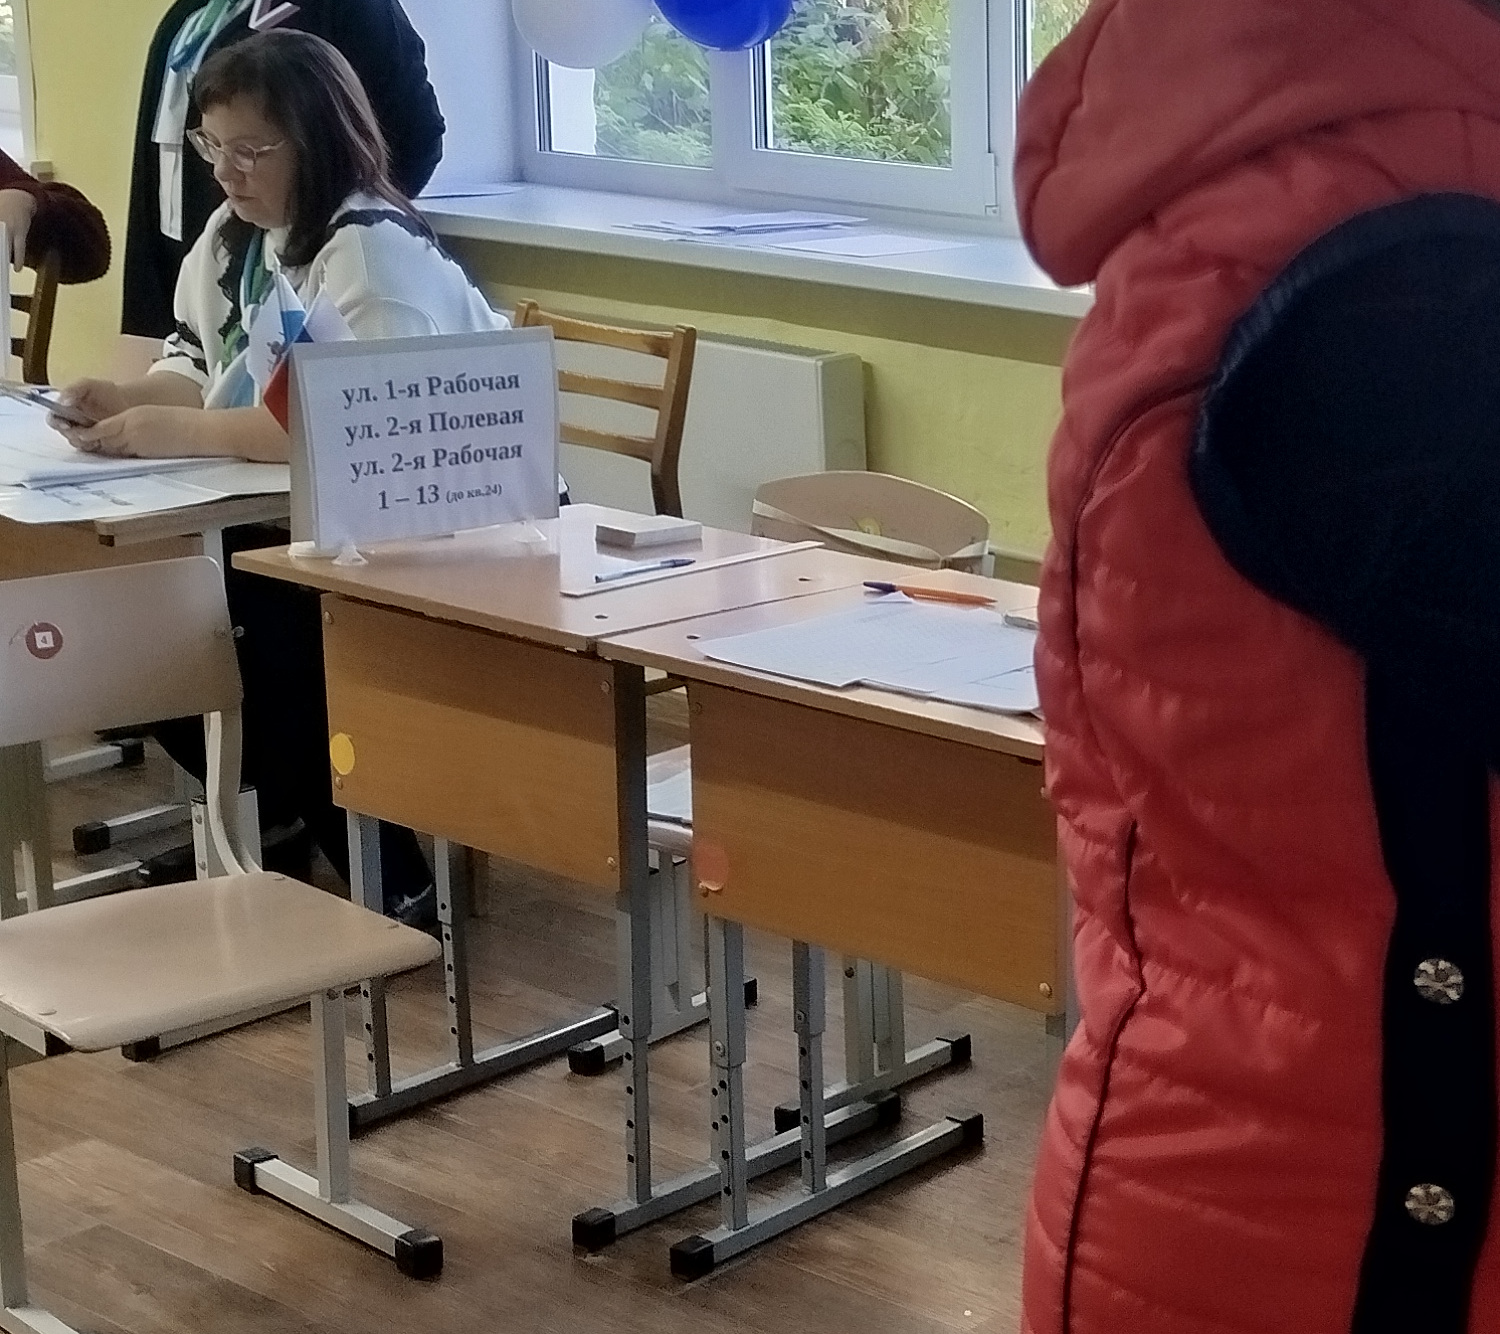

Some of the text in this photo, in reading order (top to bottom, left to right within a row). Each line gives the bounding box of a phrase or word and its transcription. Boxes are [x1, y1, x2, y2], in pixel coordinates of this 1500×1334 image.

[341, 372, 521, 410] ул. 1-я Рабочая
[344, 409, 524, 447] ул. 2-я Полевая
[350, 443, 523, 484] ул. 2-я Рабочая
[378, 490, 390, 510] 1
[416, 484, 440, 505] 13
[445, 489, 465, 504] (до
